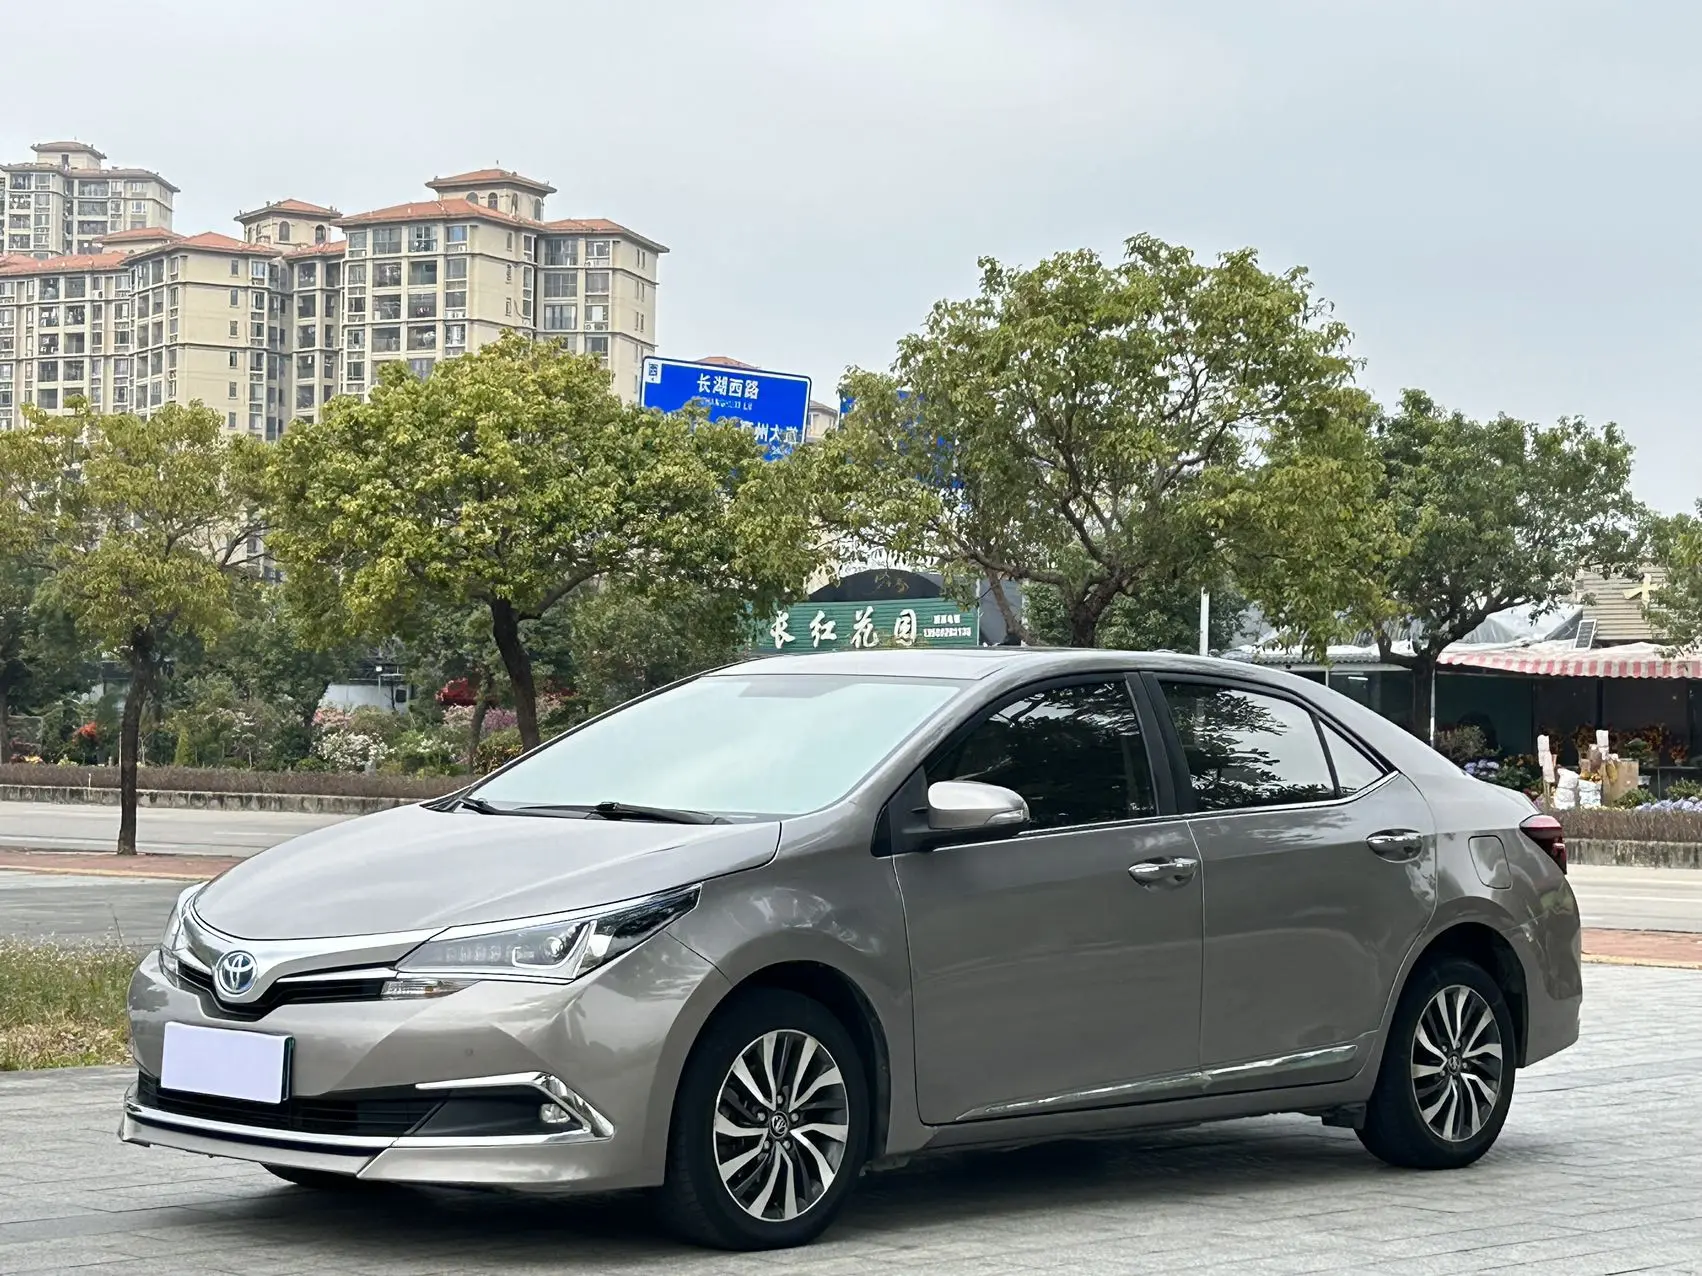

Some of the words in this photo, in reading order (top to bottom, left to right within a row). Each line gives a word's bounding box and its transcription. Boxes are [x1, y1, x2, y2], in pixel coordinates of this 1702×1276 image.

[697, 373, 759, 400] 长湖西路
[740, 420, 799, 444] 州大道
